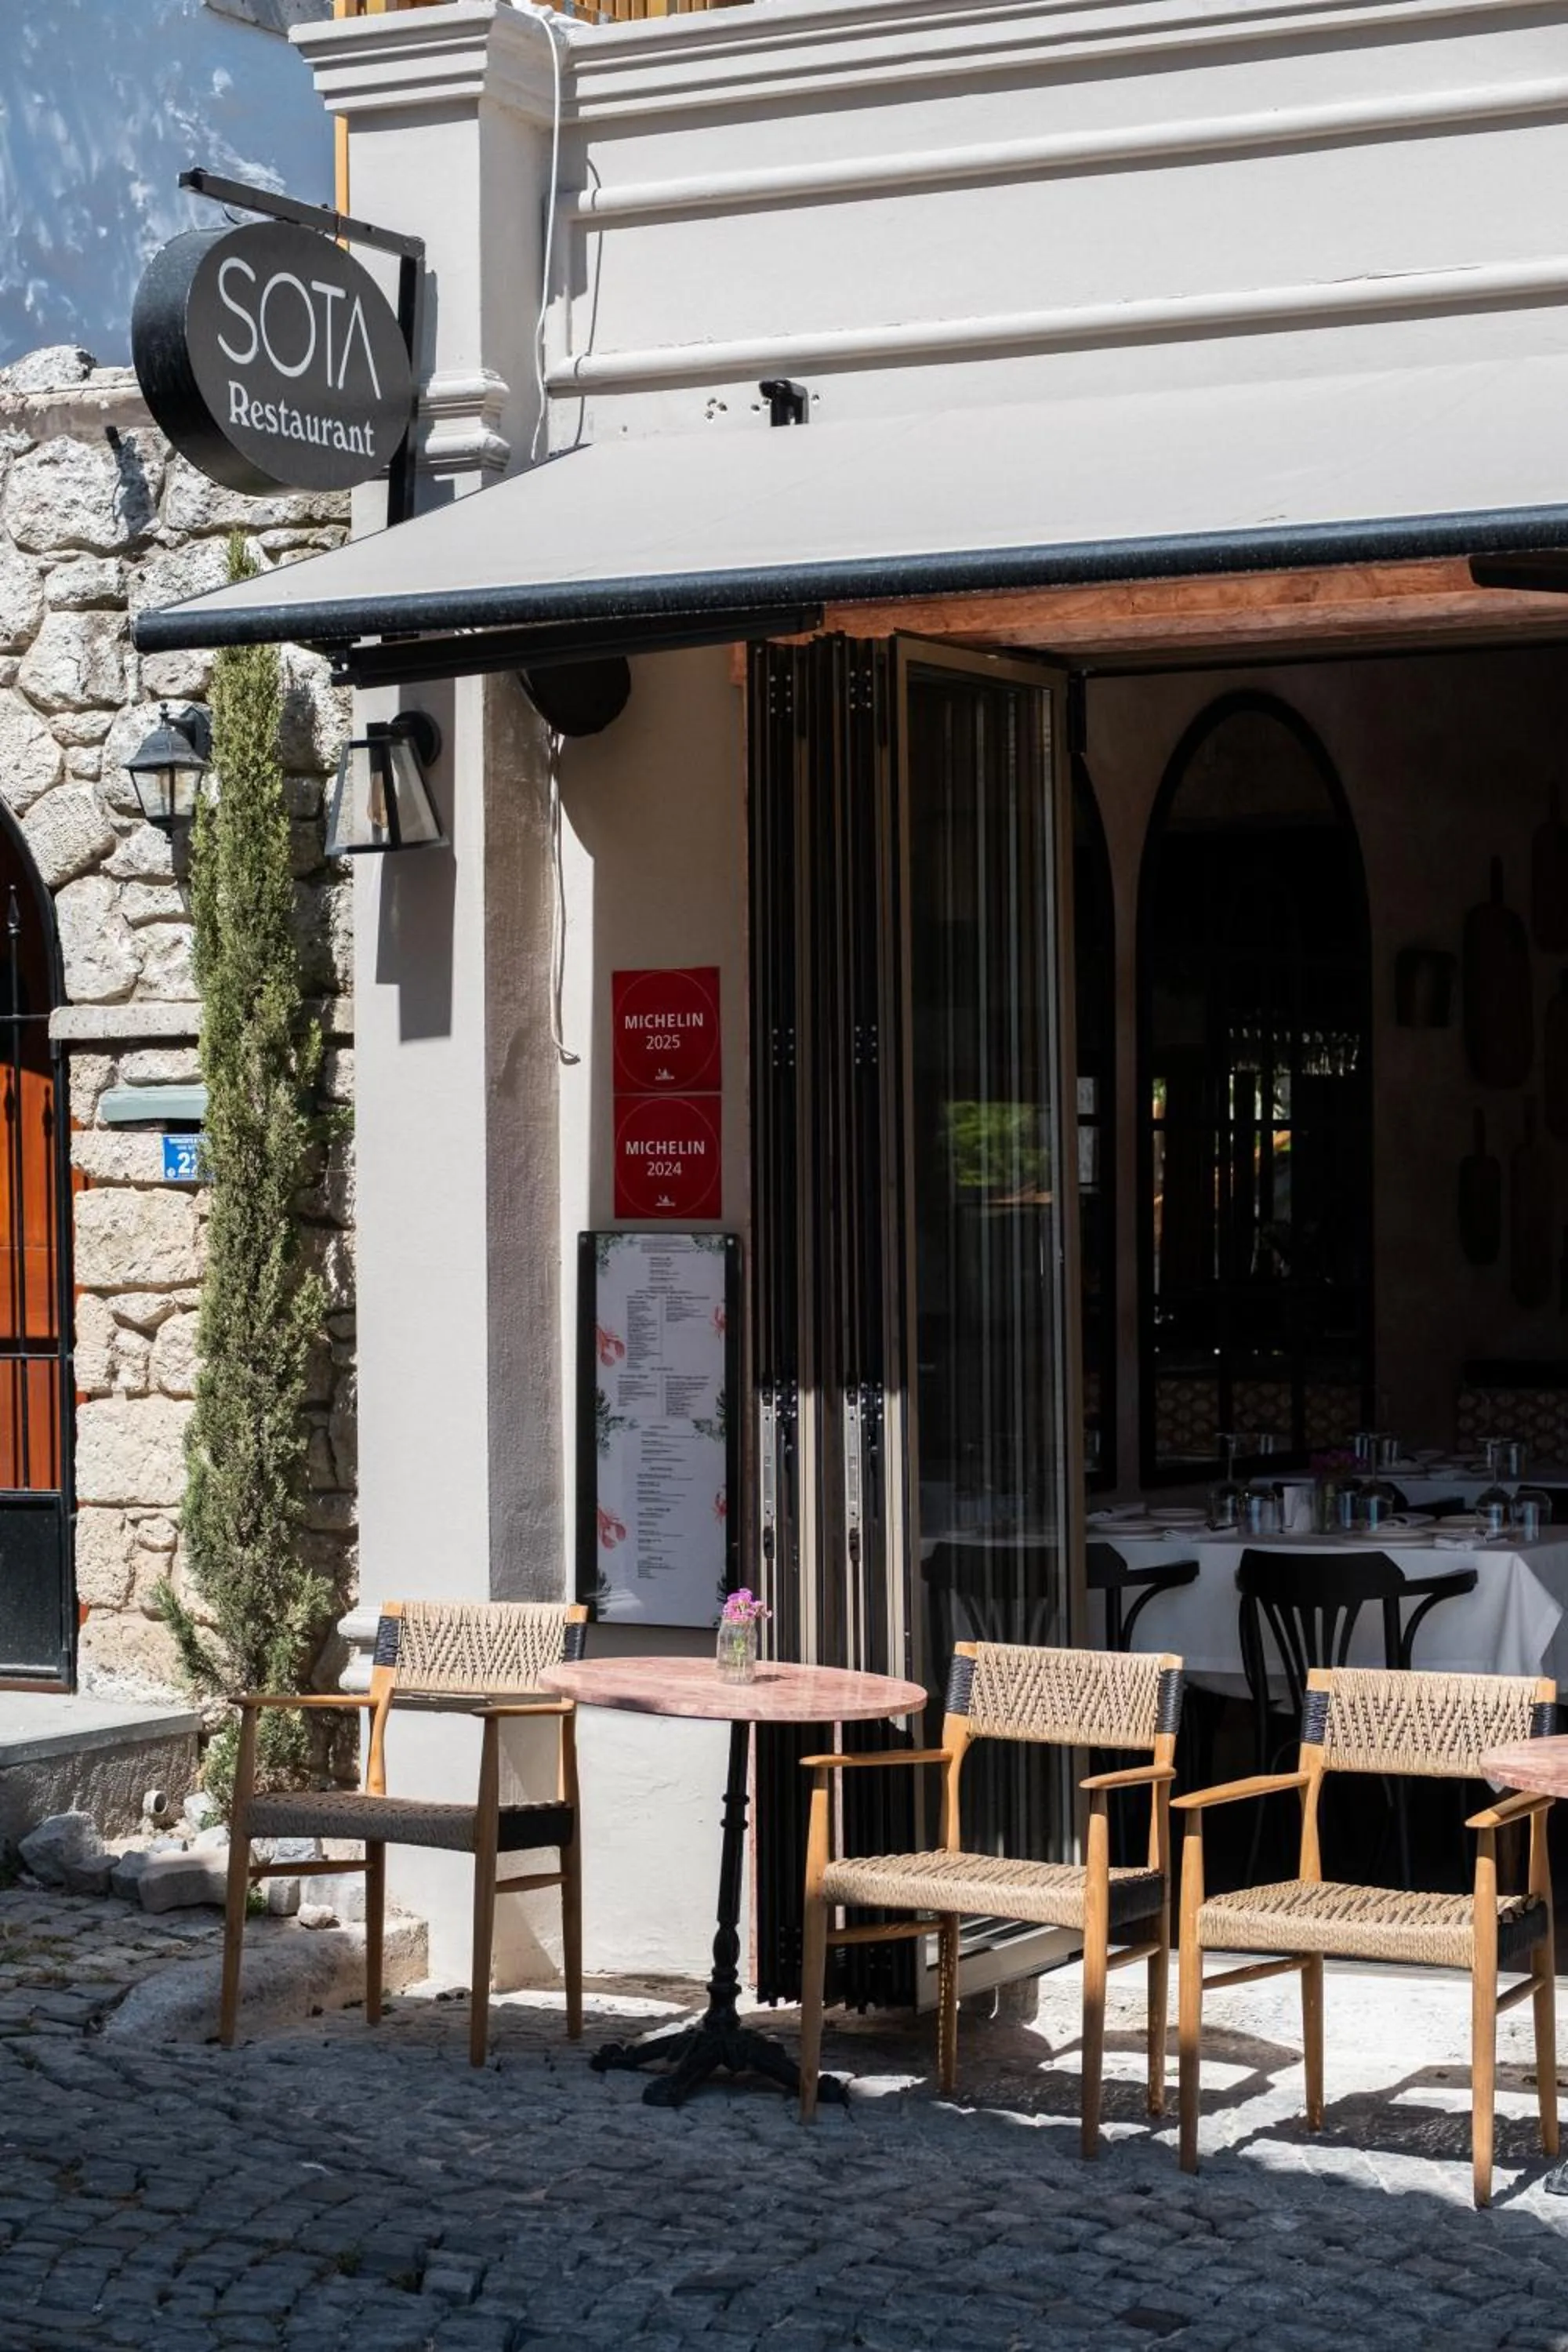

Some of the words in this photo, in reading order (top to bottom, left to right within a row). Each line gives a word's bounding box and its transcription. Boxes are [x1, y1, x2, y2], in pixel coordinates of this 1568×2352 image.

[218, 257, 382, 400] SOTA
[228, 380, 376, 457] Restaurant
[625, 1012, 703, 1029] MICHELIN
[645, 1034, 681, 1050] 2025
[626, 1141, 705, 1155] MICHELIN
[647, 1161, 682, 1176] 2024
